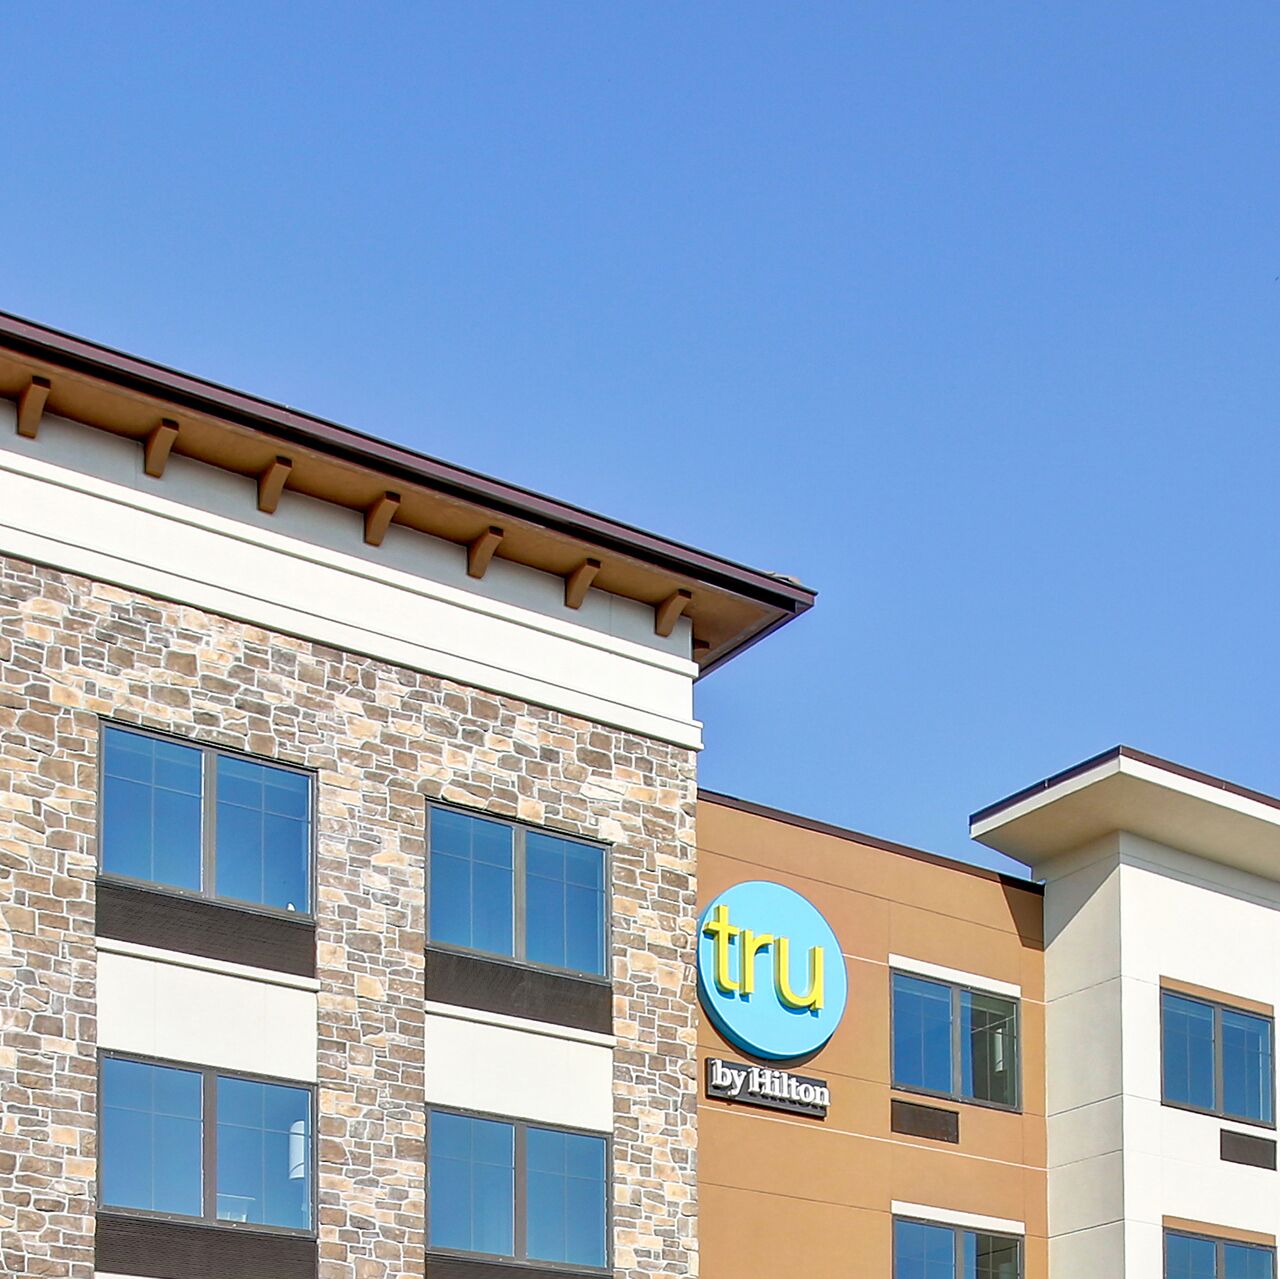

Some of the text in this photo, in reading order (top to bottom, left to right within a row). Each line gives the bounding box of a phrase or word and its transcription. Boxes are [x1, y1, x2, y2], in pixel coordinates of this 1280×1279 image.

[703, 904, 824, 1010] tru
[711, 1059, 831, 1106] by Hilton
